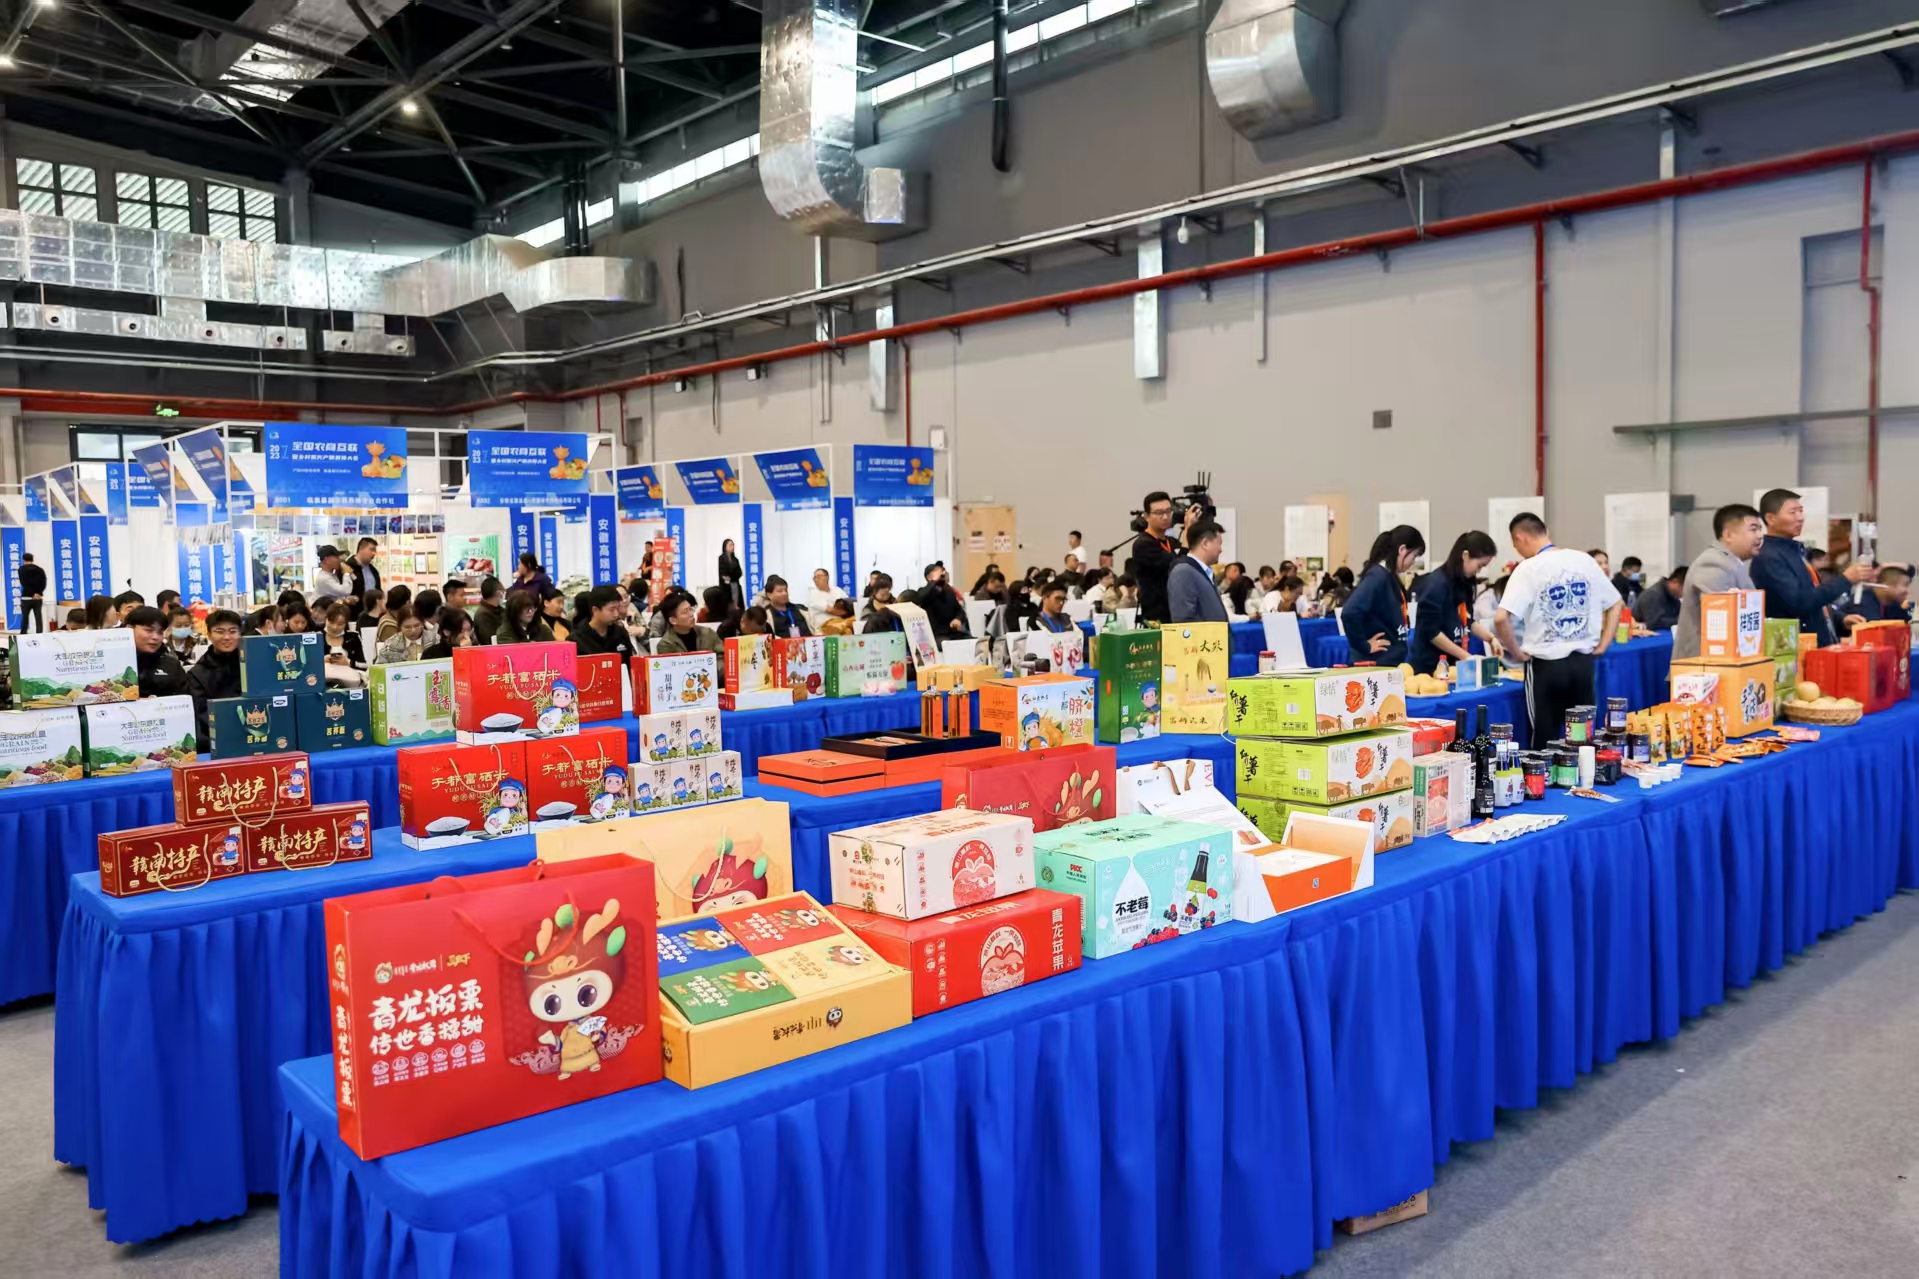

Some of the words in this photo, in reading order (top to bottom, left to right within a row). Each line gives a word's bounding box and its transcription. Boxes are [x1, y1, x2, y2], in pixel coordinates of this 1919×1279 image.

[269, 444, 280, 452] 20
[269, 452, 280, 460] 23
[292, 441, 358, 452] 全国农商互联
[60, 539, 74, 600] 安徽高端绿色
[487, 669, 562, 686] 于都富硒米
[1366, 677, 1380, 708] 红薯干
[1069, 696, 1084, 740] 脐橙
[1230, 689, 1250, 728] 红薯干
[541, 757, 613, 776] 于都富硒米
[1239, 748, 1259, 785] 红薯干
[1377, 743, 1388, 772] 红薯干
[196, 776, 267, 803] 赣南特产
[431, 769, 510, 789] 于都富硒米
[258, 827, 327, 855] 赣南特产
[129, 844, 201, 875] 赣南特产
[1070, 863, 1082, 873] PICC
[1115, 896, 1149, 916] 不老莓
[1052, 908, 1065, 971] 青龙苹果
[368, 979, 484, 1031] 青龙板栗
[369, 1014, 484, 1055] 传世香糯甜
